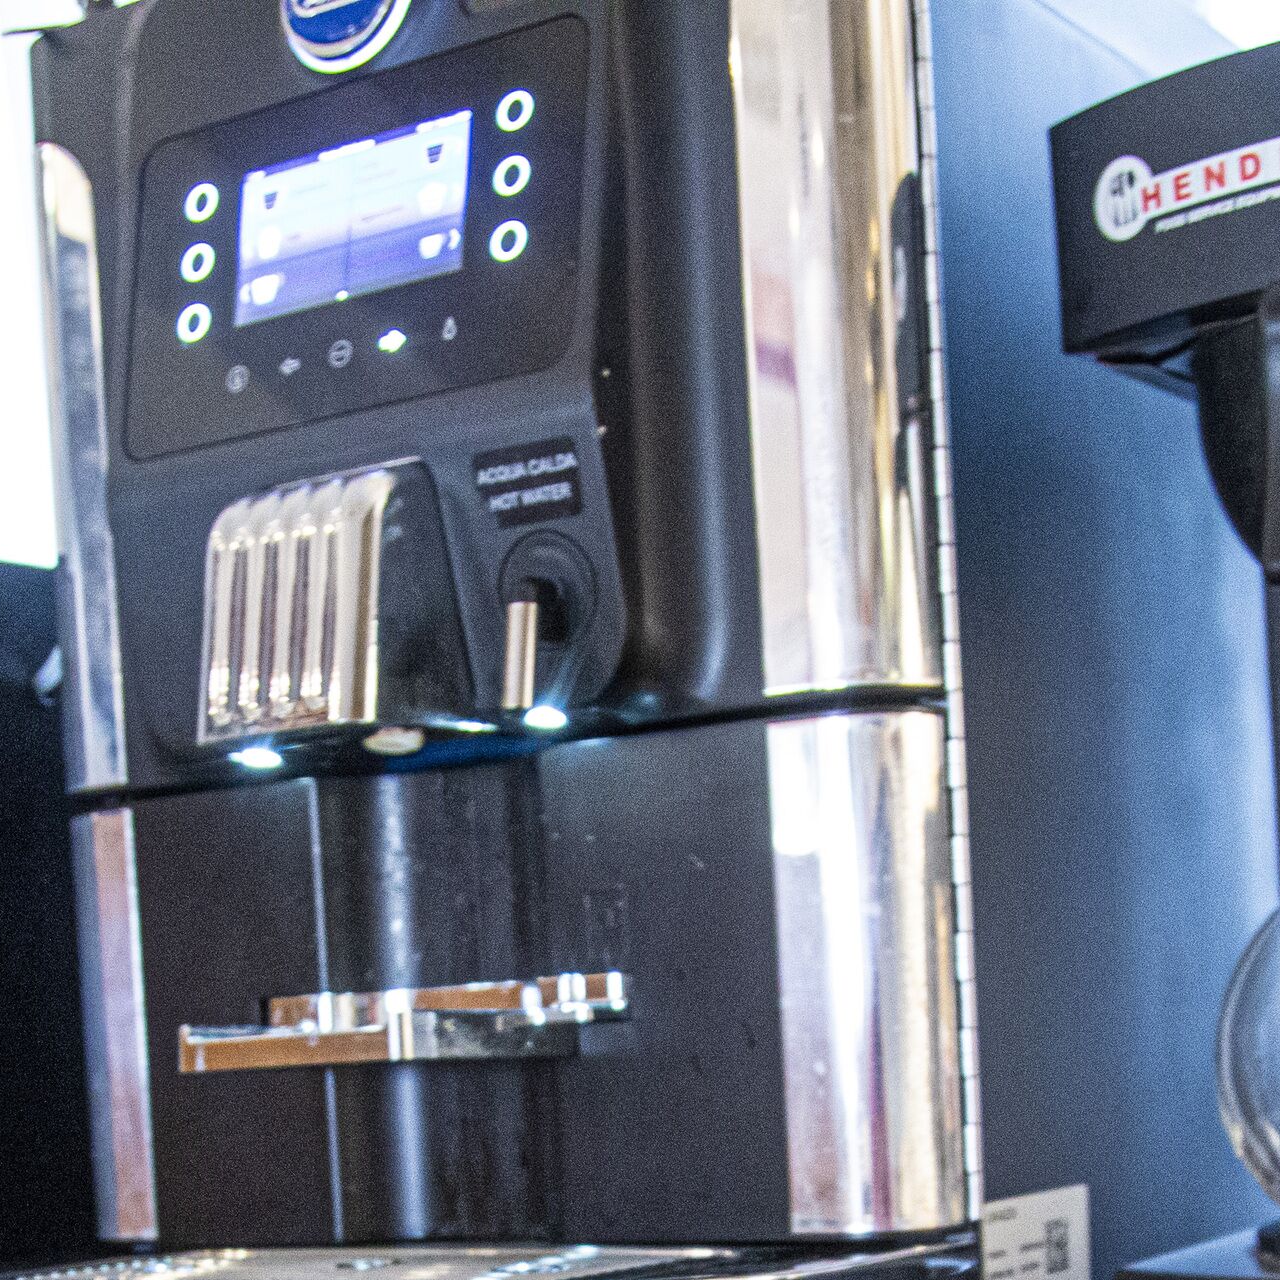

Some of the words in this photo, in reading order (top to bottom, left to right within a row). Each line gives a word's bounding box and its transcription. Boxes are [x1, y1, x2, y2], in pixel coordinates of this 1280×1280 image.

[476, 461, 526, 486] ACQUA
[527, 452, 579, 476] CALDA
[489, 490, 520, 512] HOT
[521, 481, 572, 506] WATER
